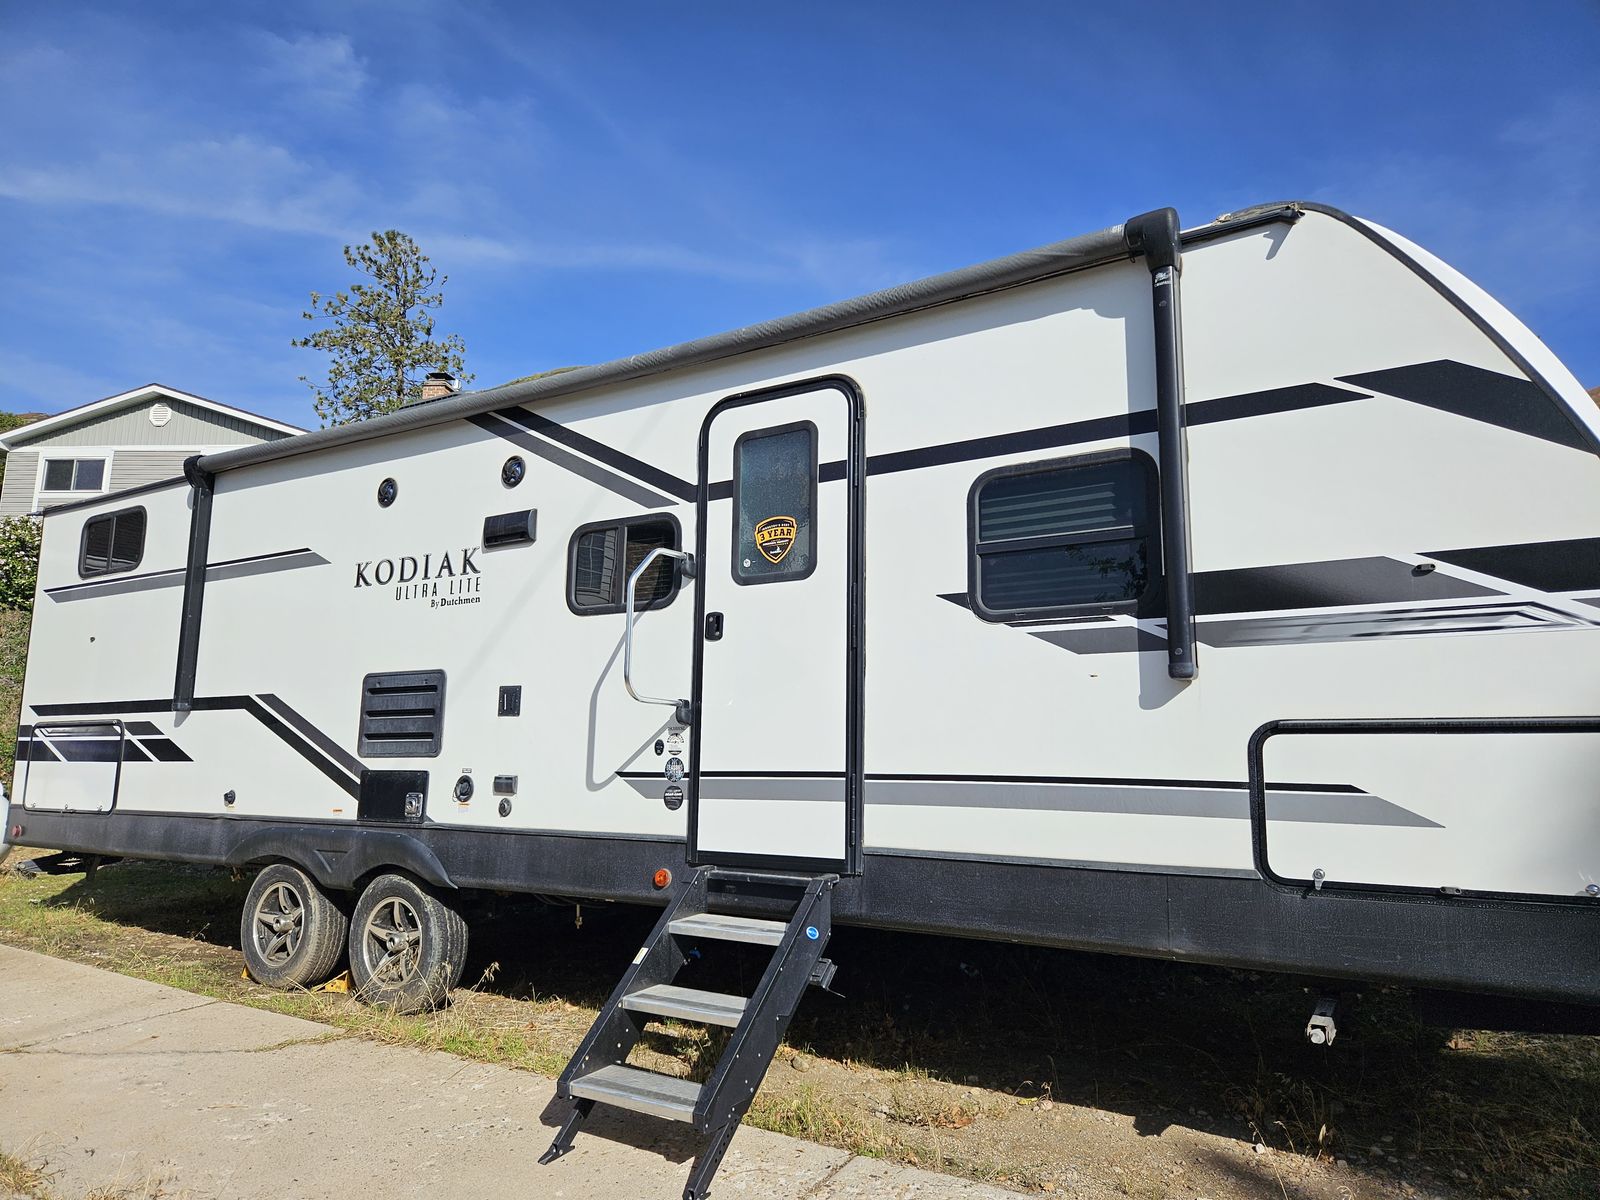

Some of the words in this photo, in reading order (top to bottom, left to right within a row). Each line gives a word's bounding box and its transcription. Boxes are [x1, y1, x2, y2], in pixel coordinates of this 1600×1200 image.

[768, 528, 792, 538] YEAR
[354, 546, 481, 588] KODIAK
[395, 582, 438, 601] ULTRA
[449, 576, 481, 595] LITE
[430, 599, 440, 609] By
[440, 596, 481, 607] Dutchmen
